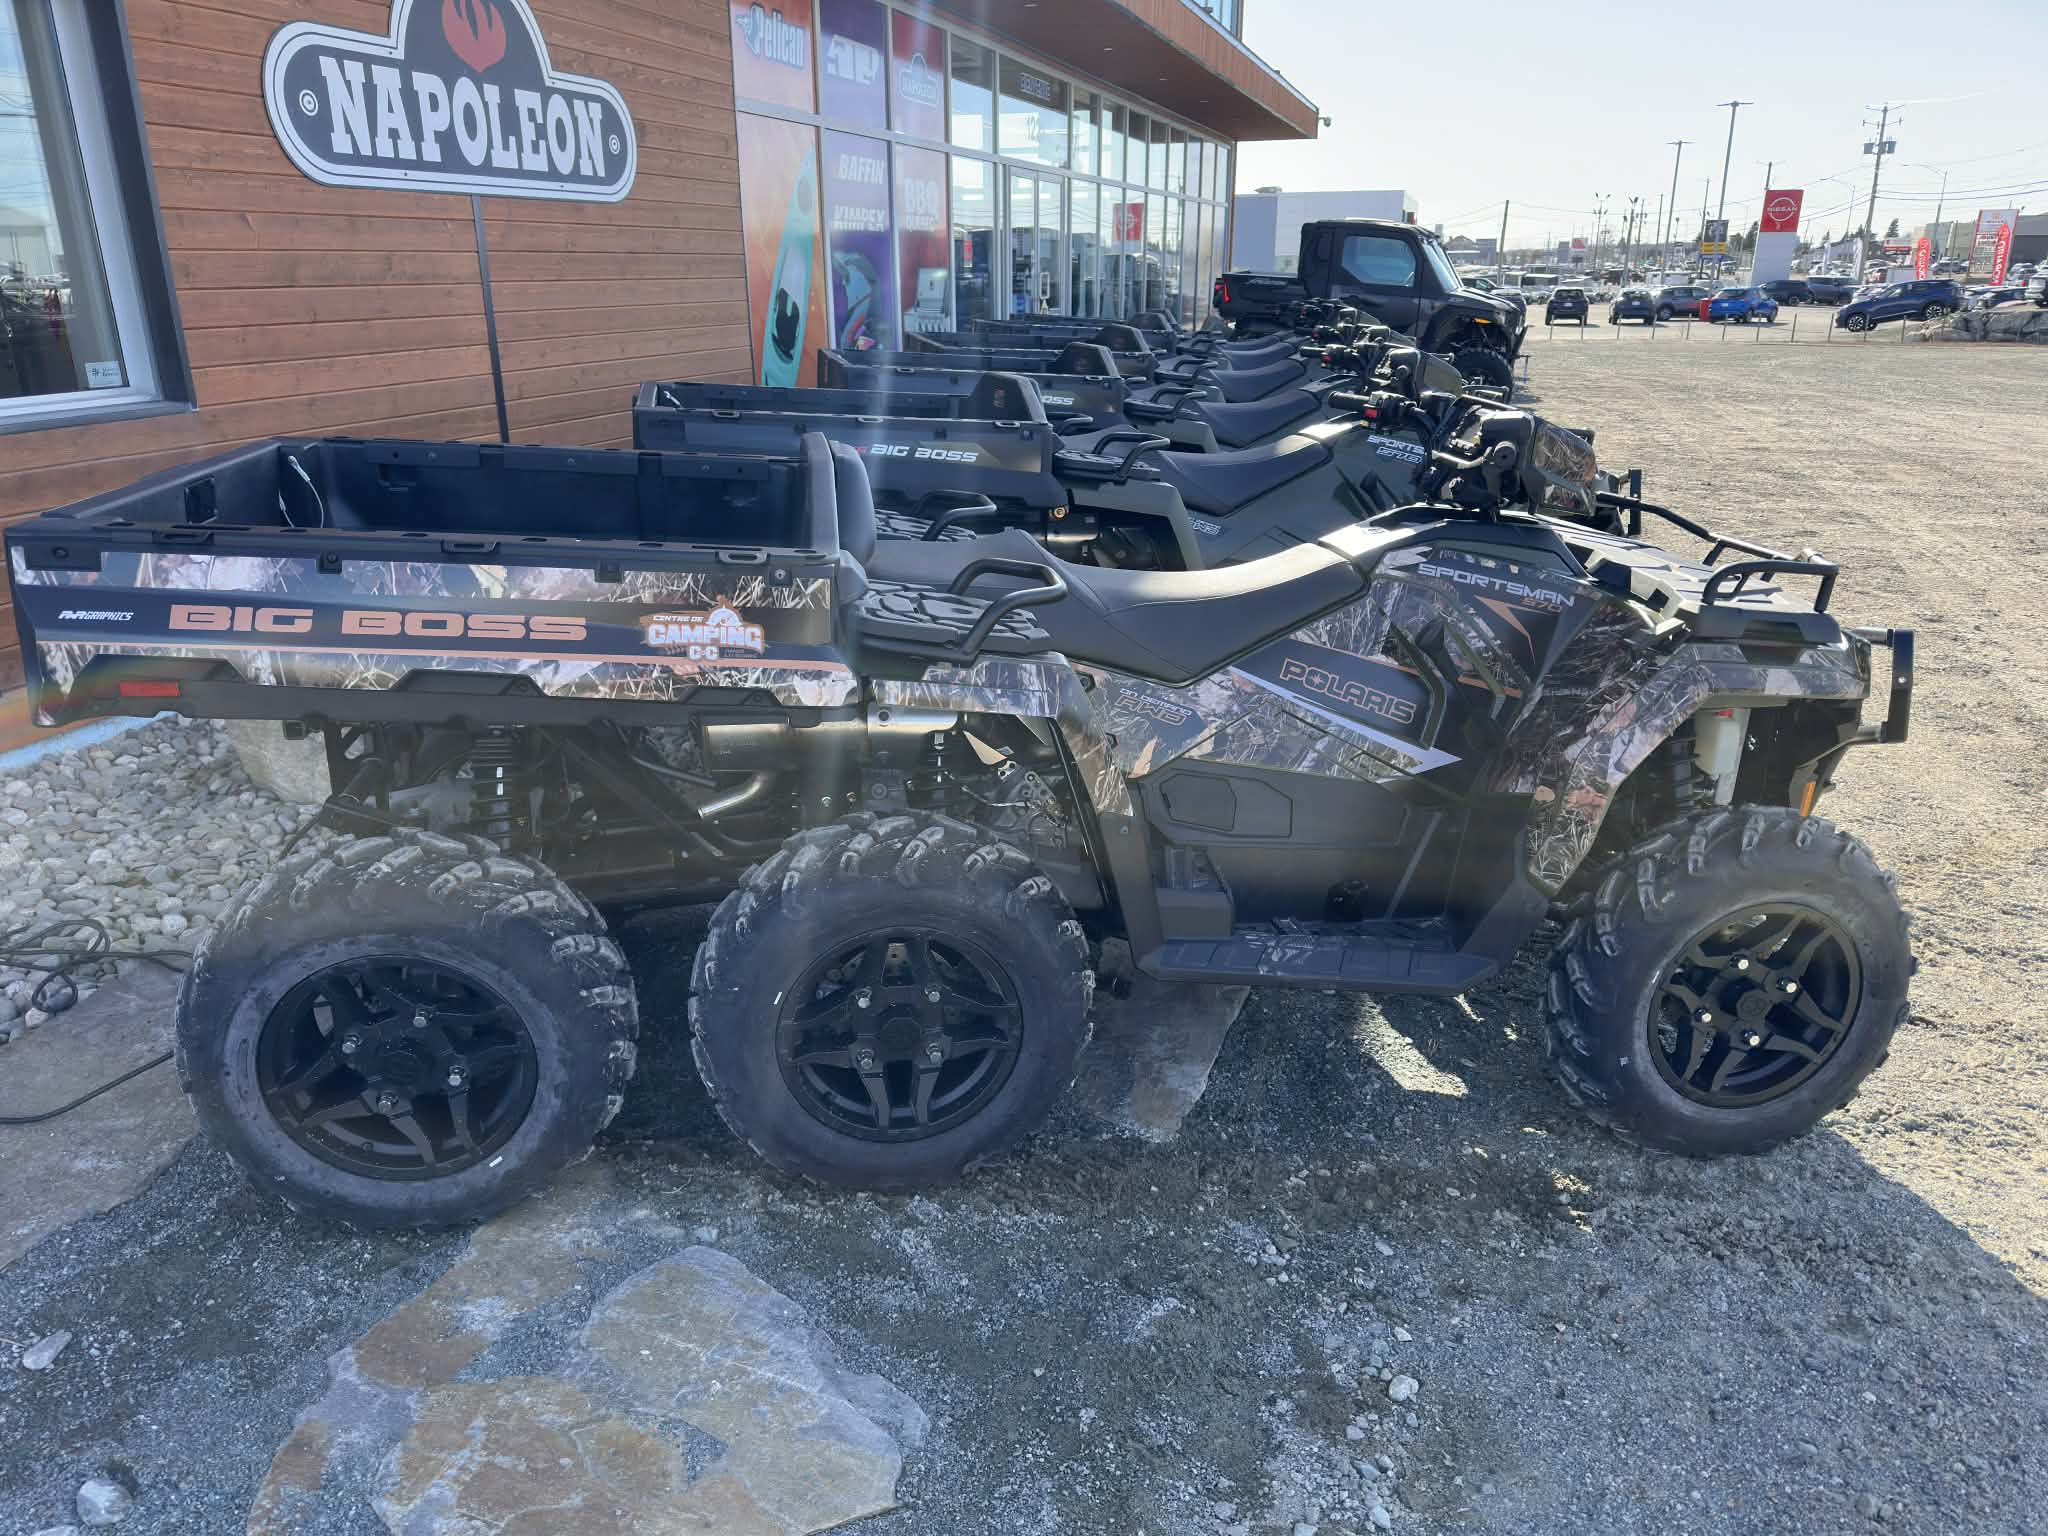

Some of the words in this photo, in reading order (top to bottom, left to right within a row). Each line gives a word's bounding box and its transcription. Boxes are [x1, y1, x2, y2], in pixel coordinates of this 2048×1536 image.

[745, 4, 806, 69] Pelican
[318, 55, 606, 178] NAPOLEON
[839, 153, 885, 185] BAFFIN
[904, 177, 940, 218] BBQ
[1041, 394, 1074, 405] OSS
[870, 443, 911, 457] BIG
[913, 447, 980, 463] BOSS
[1367, 434, 1425, 455] SPORTS
[1375, 446, 1424, 464] 570
[1417, 563, 1576, 608] SPORTSMAN
[652, 615, 690, 623] CENTRE
[1520, 597, 1563, 614] 570
[168, 604, 314, 633] BIG
[341, 610, 588, 641] BOSS
[648, 623, 762, 651] CAMPING
[1279, 656, 1417, 725] POLARIS
[1114, 694, 1187, 727] AWD
